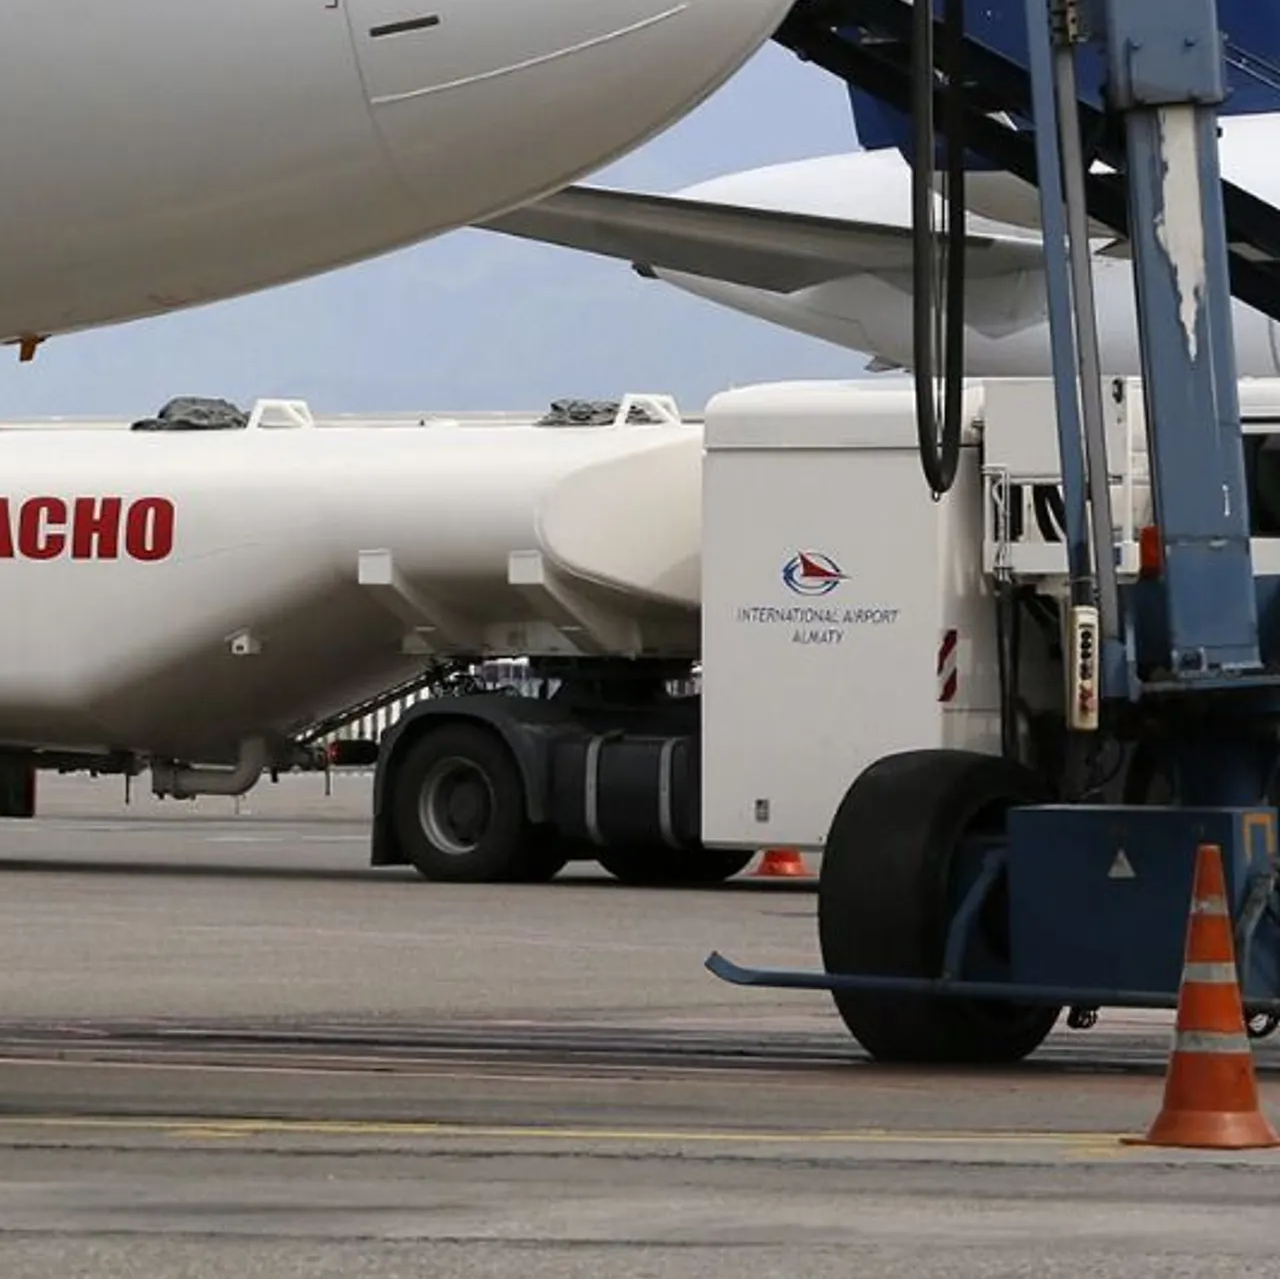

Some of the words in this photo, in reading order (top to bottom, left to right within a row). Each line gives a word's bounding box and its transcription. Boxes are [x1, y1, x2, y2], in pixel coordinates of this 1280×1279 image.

[737, 607, 839, 624] INTERNATIONAL
[842, 608, 900, 625] AIRPORT
[792, 629, 846, 645] ALMATY
